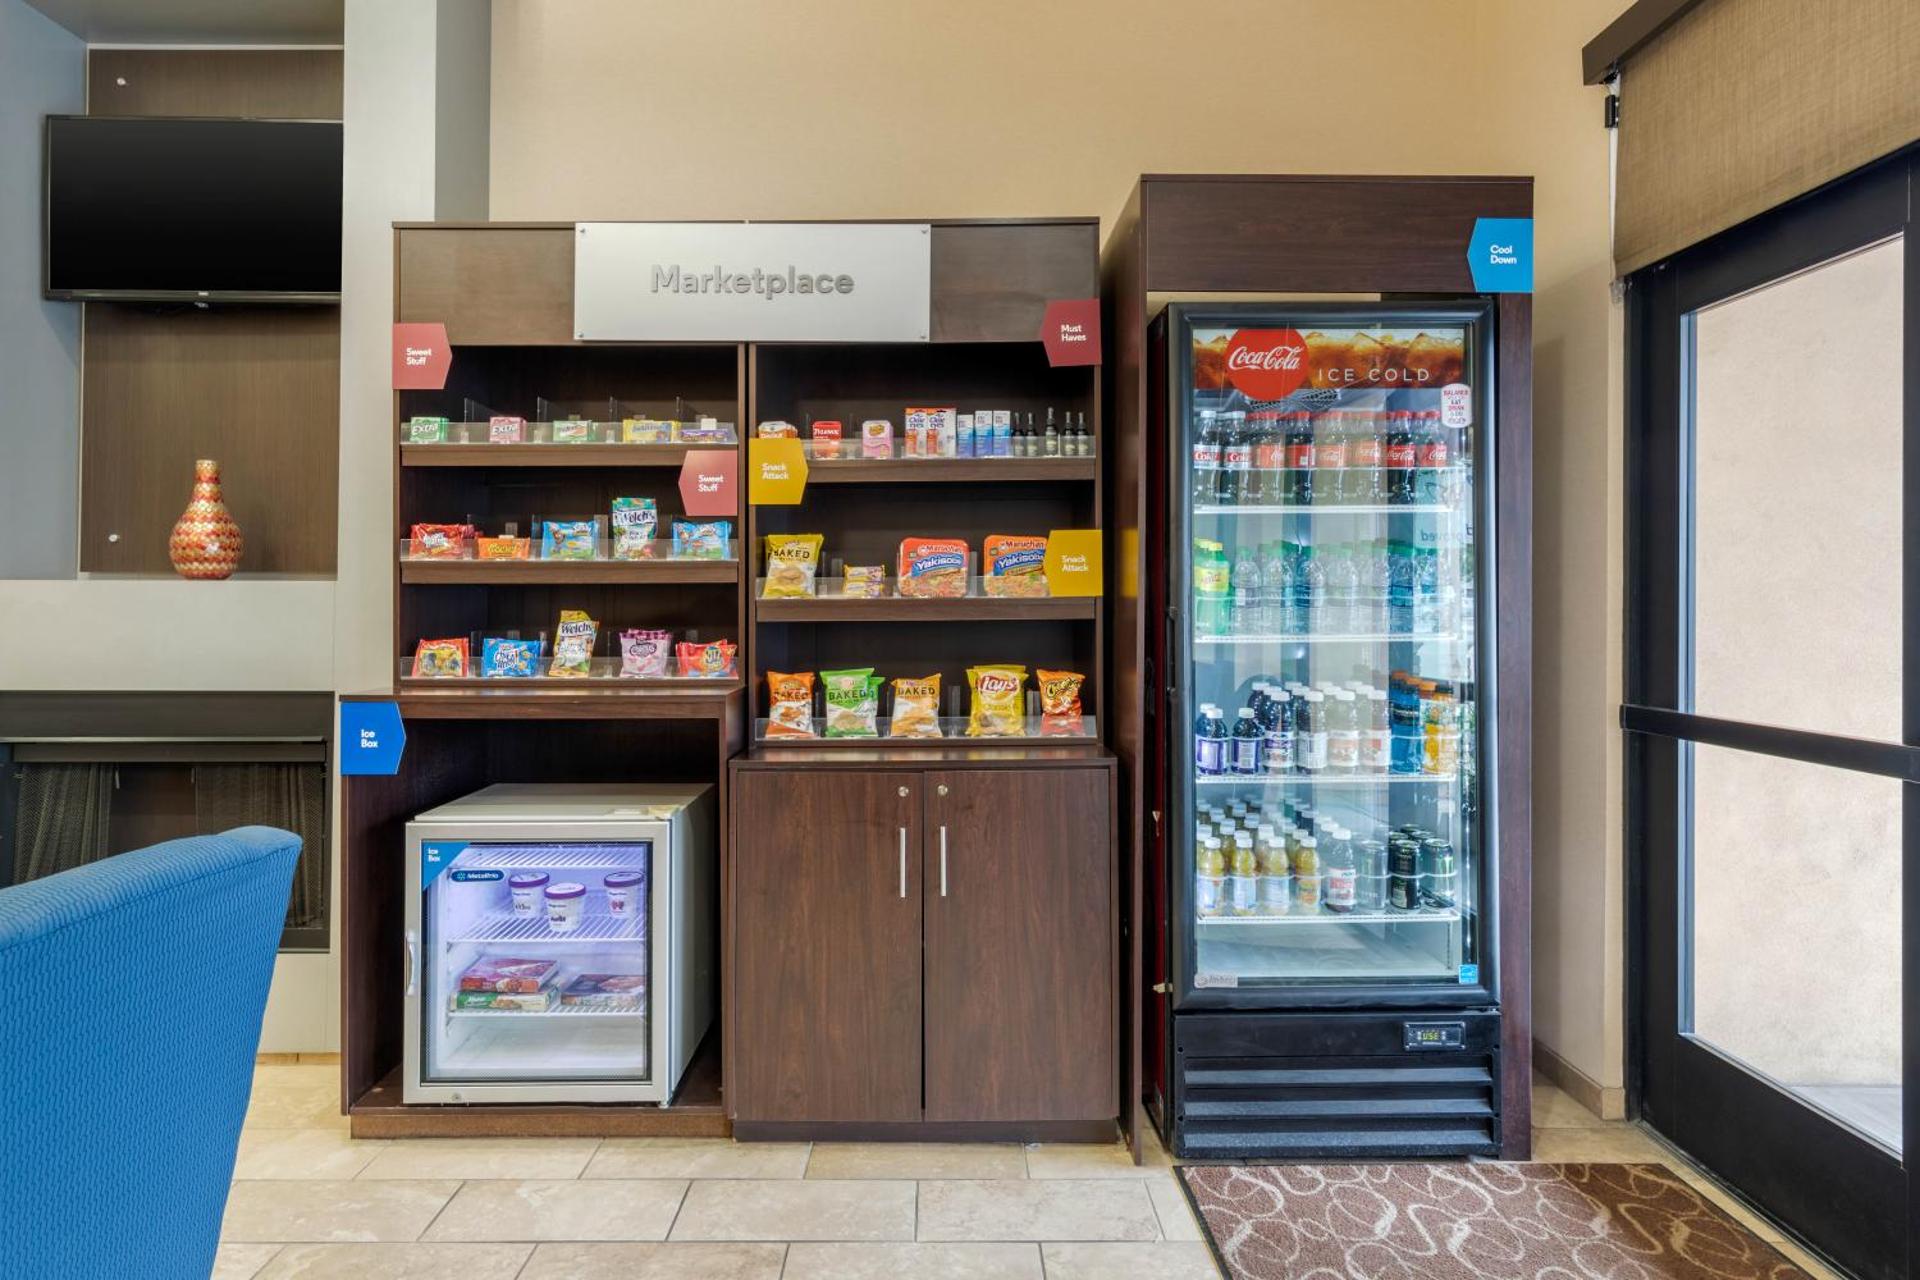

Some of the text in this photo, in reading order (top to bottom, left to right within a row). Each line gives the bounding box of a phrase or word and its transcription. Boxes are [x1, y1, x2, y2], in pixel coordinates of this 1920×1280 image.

[1490, 244, 1513, 254] Cool
[1490, 255, 1517, 264] Down
[650, 264, 854, 300] Marketplace
[1060, 324, 1082, 333] Must
[1061, 333, 1087, 342] Haves
[406, 347, 432, 356] Sweet
[406, 357, 427, 366] Stuff
[1228, 345, 1304, 370] Coca-Cola
[1318, 368, 1430, 382] ICE COLD
[761, 463, 785, 471] Snack
[698, 474, 724, 483] Sweet
[762, 471, 789, 480] Attack
[697, 483, 718, 492] Stuff
[1006, 540, 1044, 548] Maruchan
[773, 549, 810, 559] BAKED
[917, 556, 961, 570] Yakisoba
[1061, 555, 1086, 563] Snack
[1061, 563, 1088, 572] Attack
[828, 688, 867, 701] BAKED
[898, 686, 935, 696] BAKED
[360, 729, 375, 738] Ice
[360, 738, 378, 748] Box
